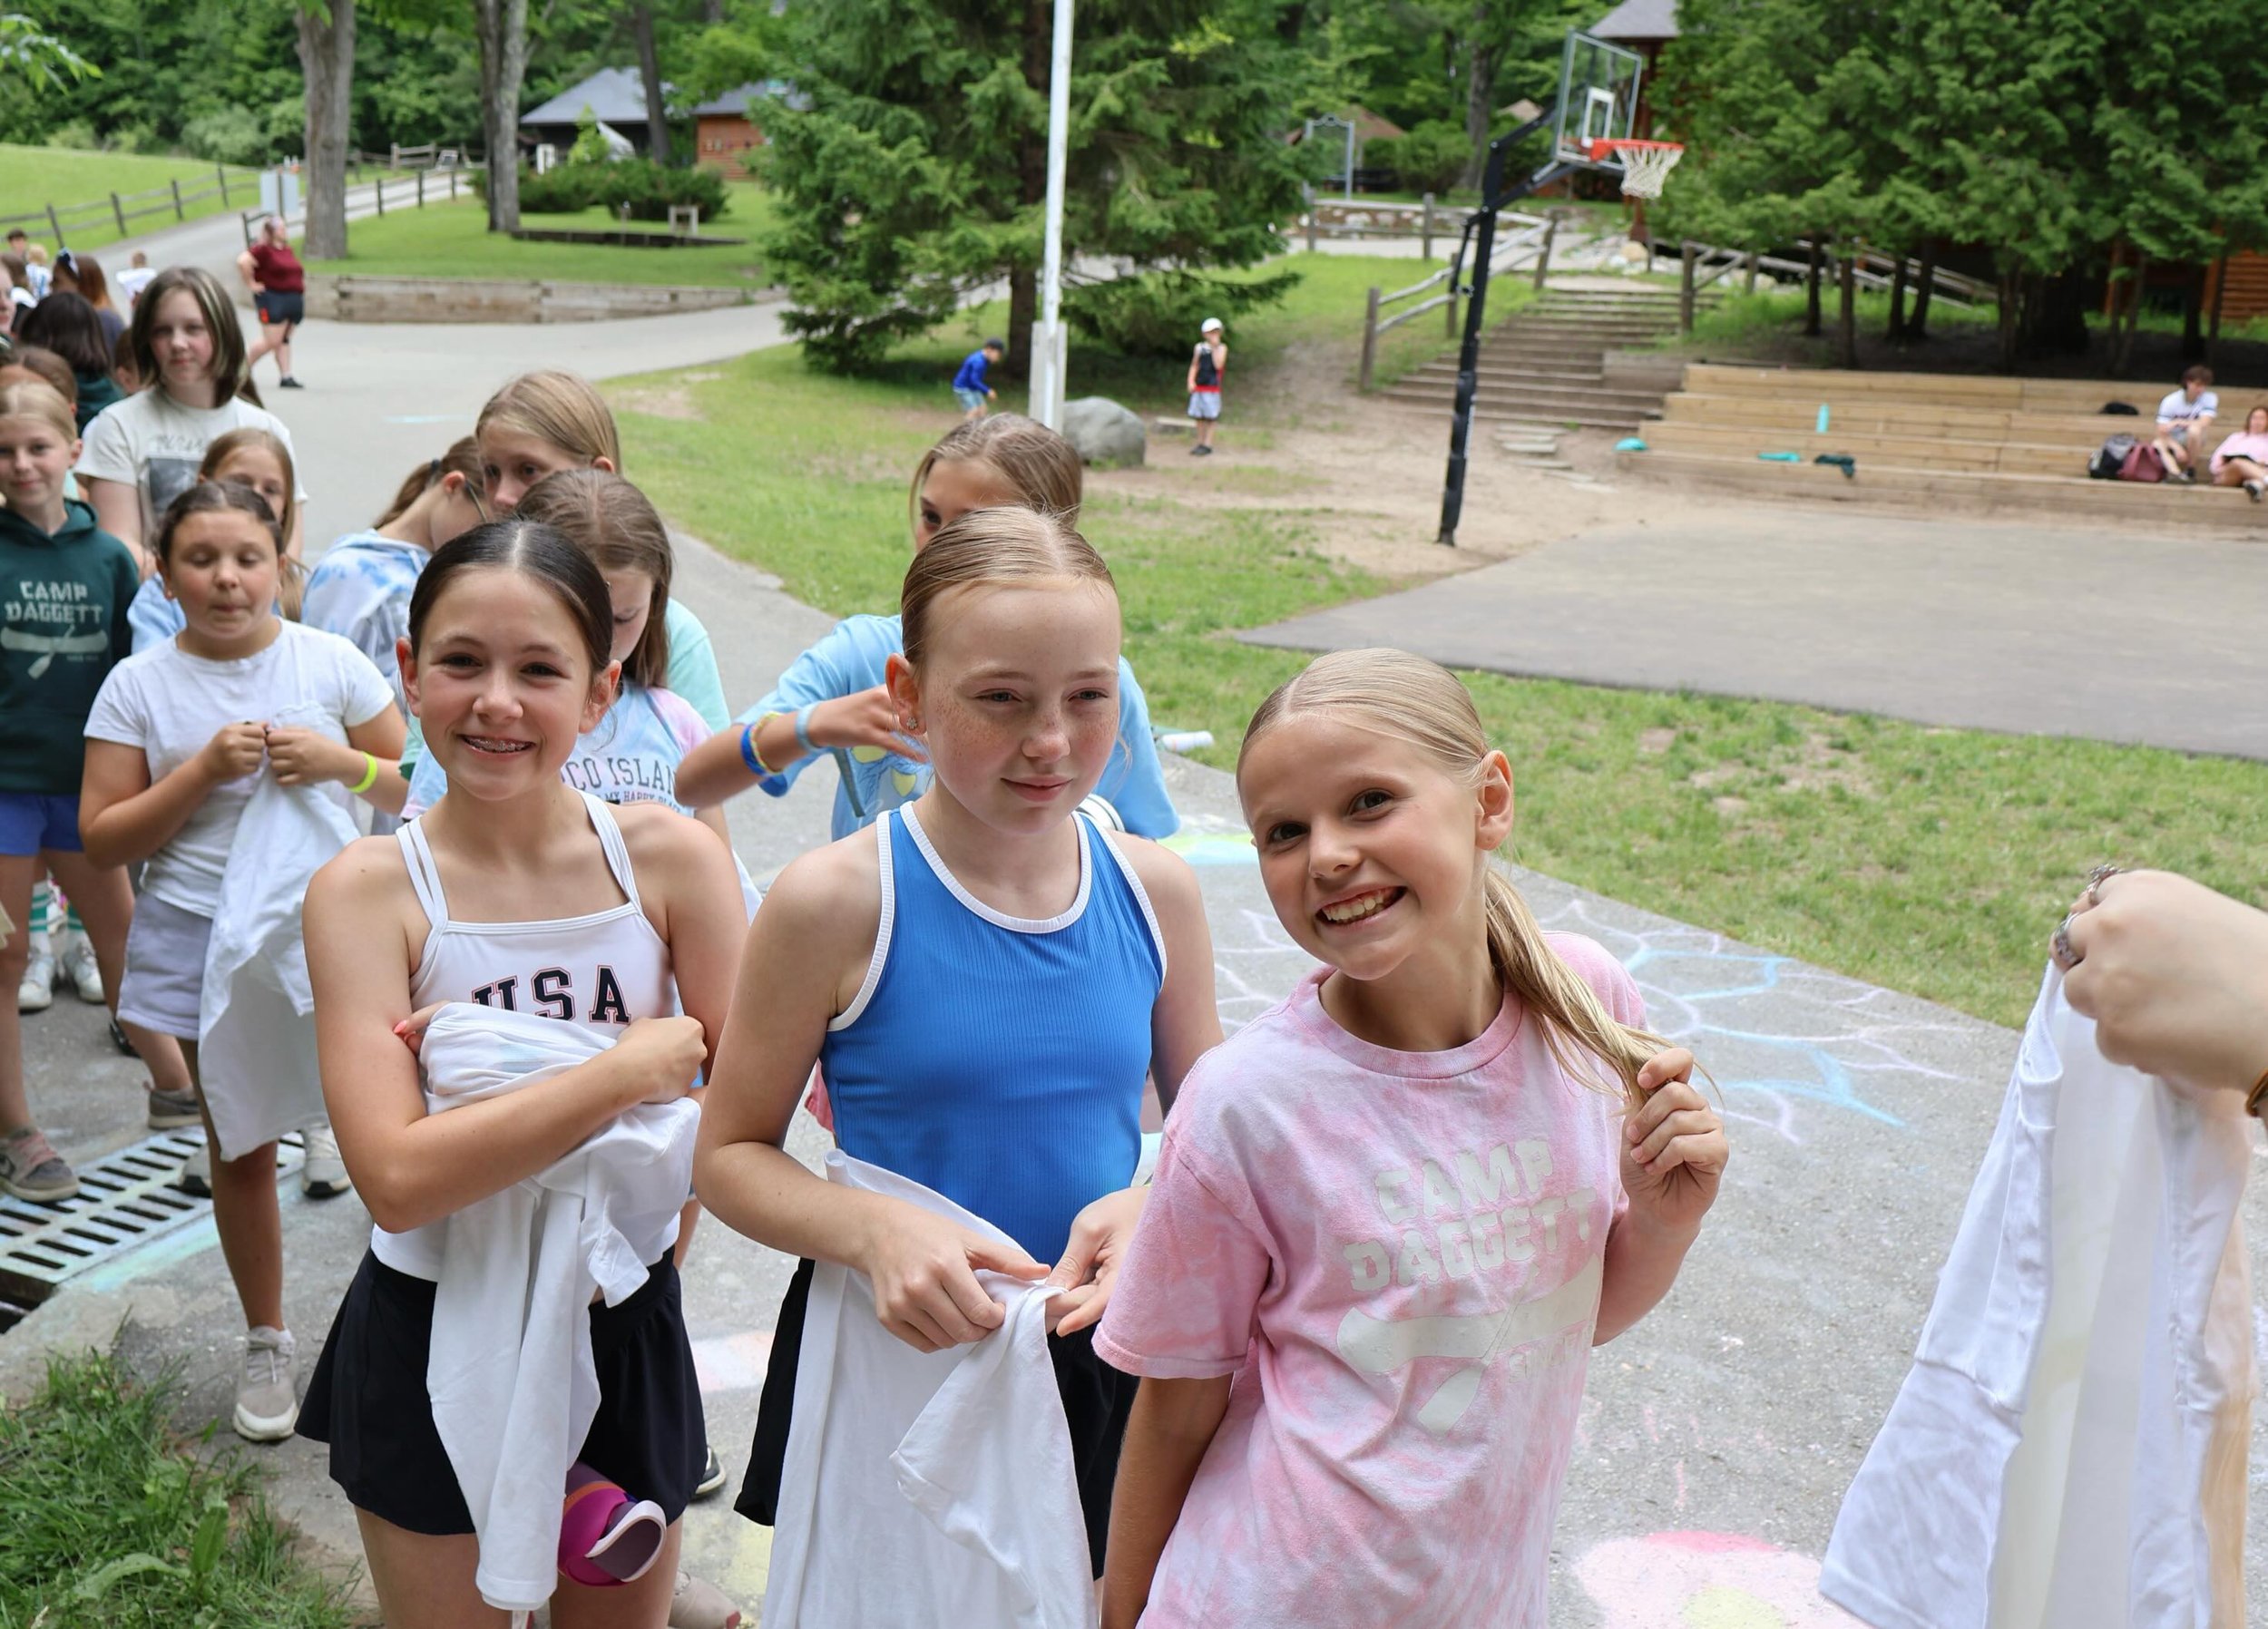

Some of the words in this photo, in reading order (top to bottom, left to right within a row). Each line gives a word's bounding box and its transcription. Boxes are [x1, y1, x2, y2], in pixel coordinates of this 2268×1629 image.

[5, 601, 103, 623] DAGGETT
[19, 580, 88, 601] CAMP
[561, 757, 601, 791] CO
[607, 757, 677, 795] ISLAN
[472, 965, 631, 1025] USA
[1374, 1139, 1553, 1224] CAMP
[1343, 1187, 1597, 1292] DAGGETT
